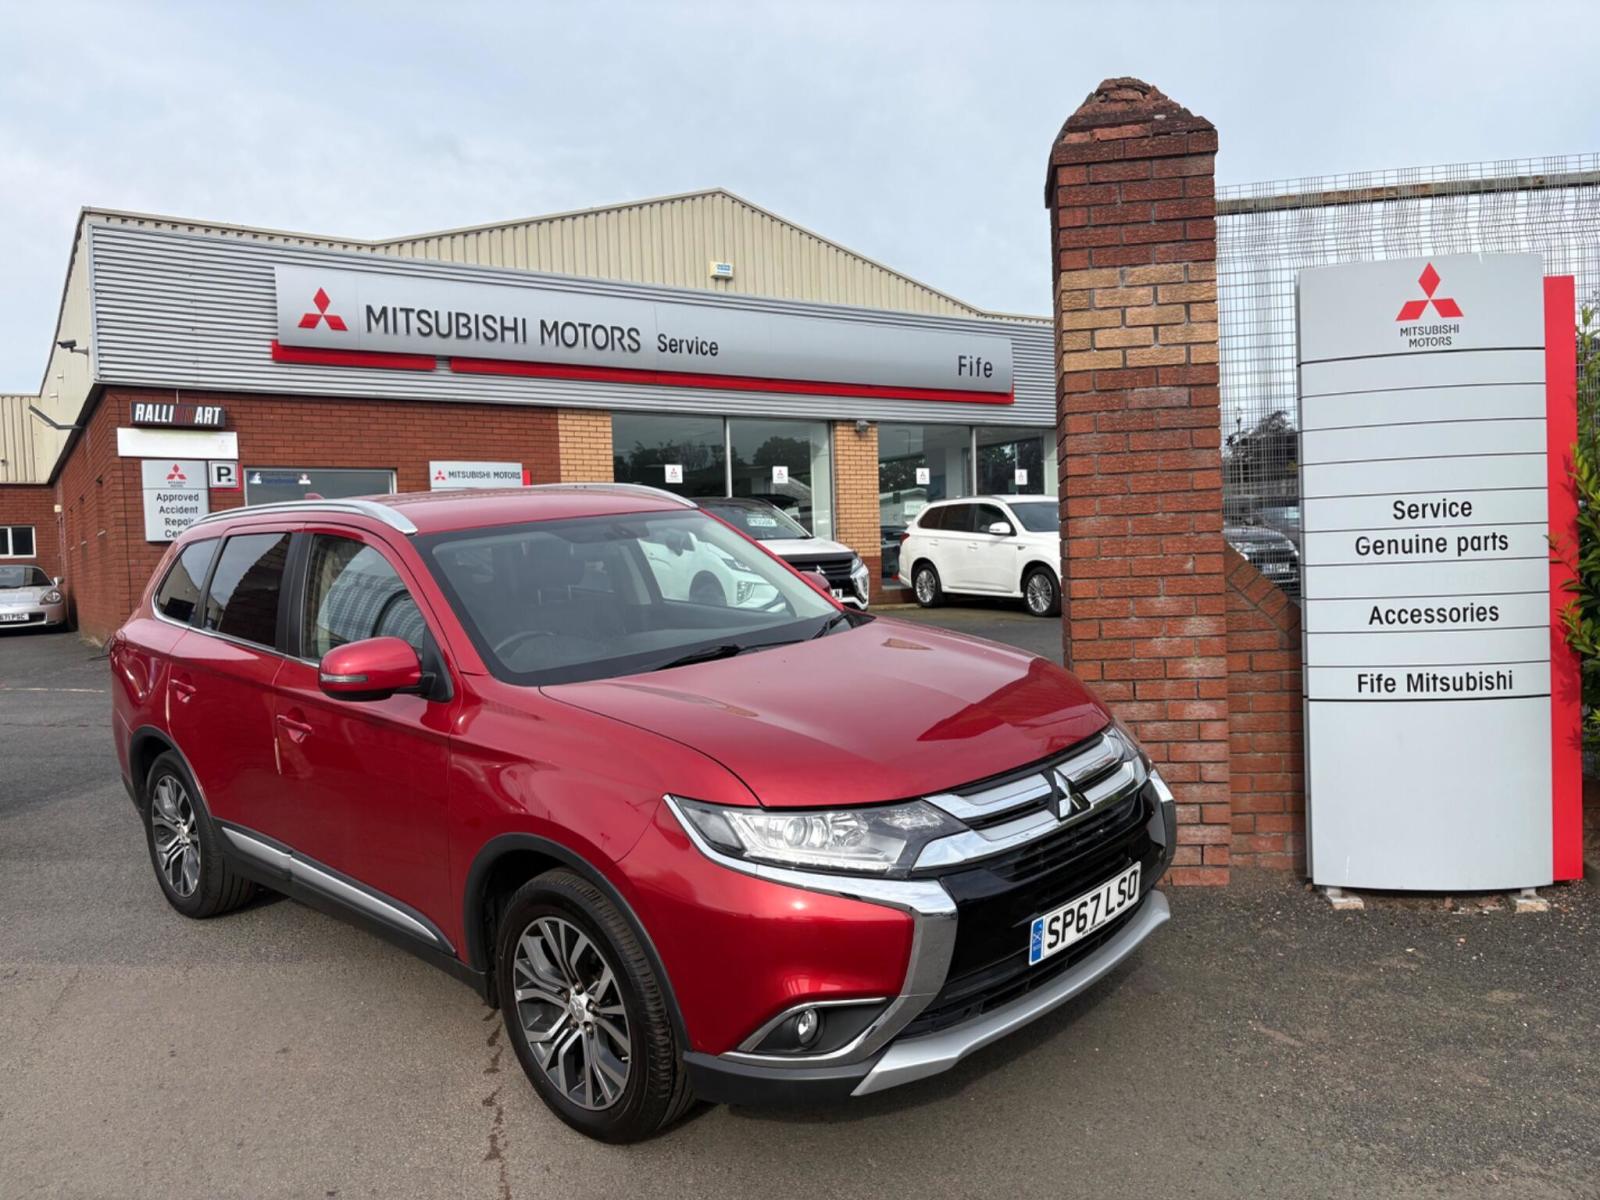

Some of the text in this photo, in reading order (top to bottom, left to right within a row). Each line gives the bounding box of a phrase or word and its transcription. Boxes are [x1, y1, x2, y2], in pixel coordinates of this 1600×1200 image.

[366, 305, 641, 353] MITSUBISHI MOTORS
[1400, 324, 1460, 337] MITSUBISHI
[657, 334, 719, 357] Service
[1409, 336, 1452, 348] MOTORS
[958, 355, 993, 378] Fife
[135, 404, 221, 424] RALLI ART
[448, 471, 521, 479] MITSUBISHI MOTORS
[156, 493, 199, 502] Approved
[159, 506, 198, 514] Accident
[1393, 498, 1472, 520] Service
[1355, 532, 1509, 556] Genuine parts
[1368, 603, 1499, 625] Accessories
[1357, 670, 1513, 693] Fife Mitsubishi
